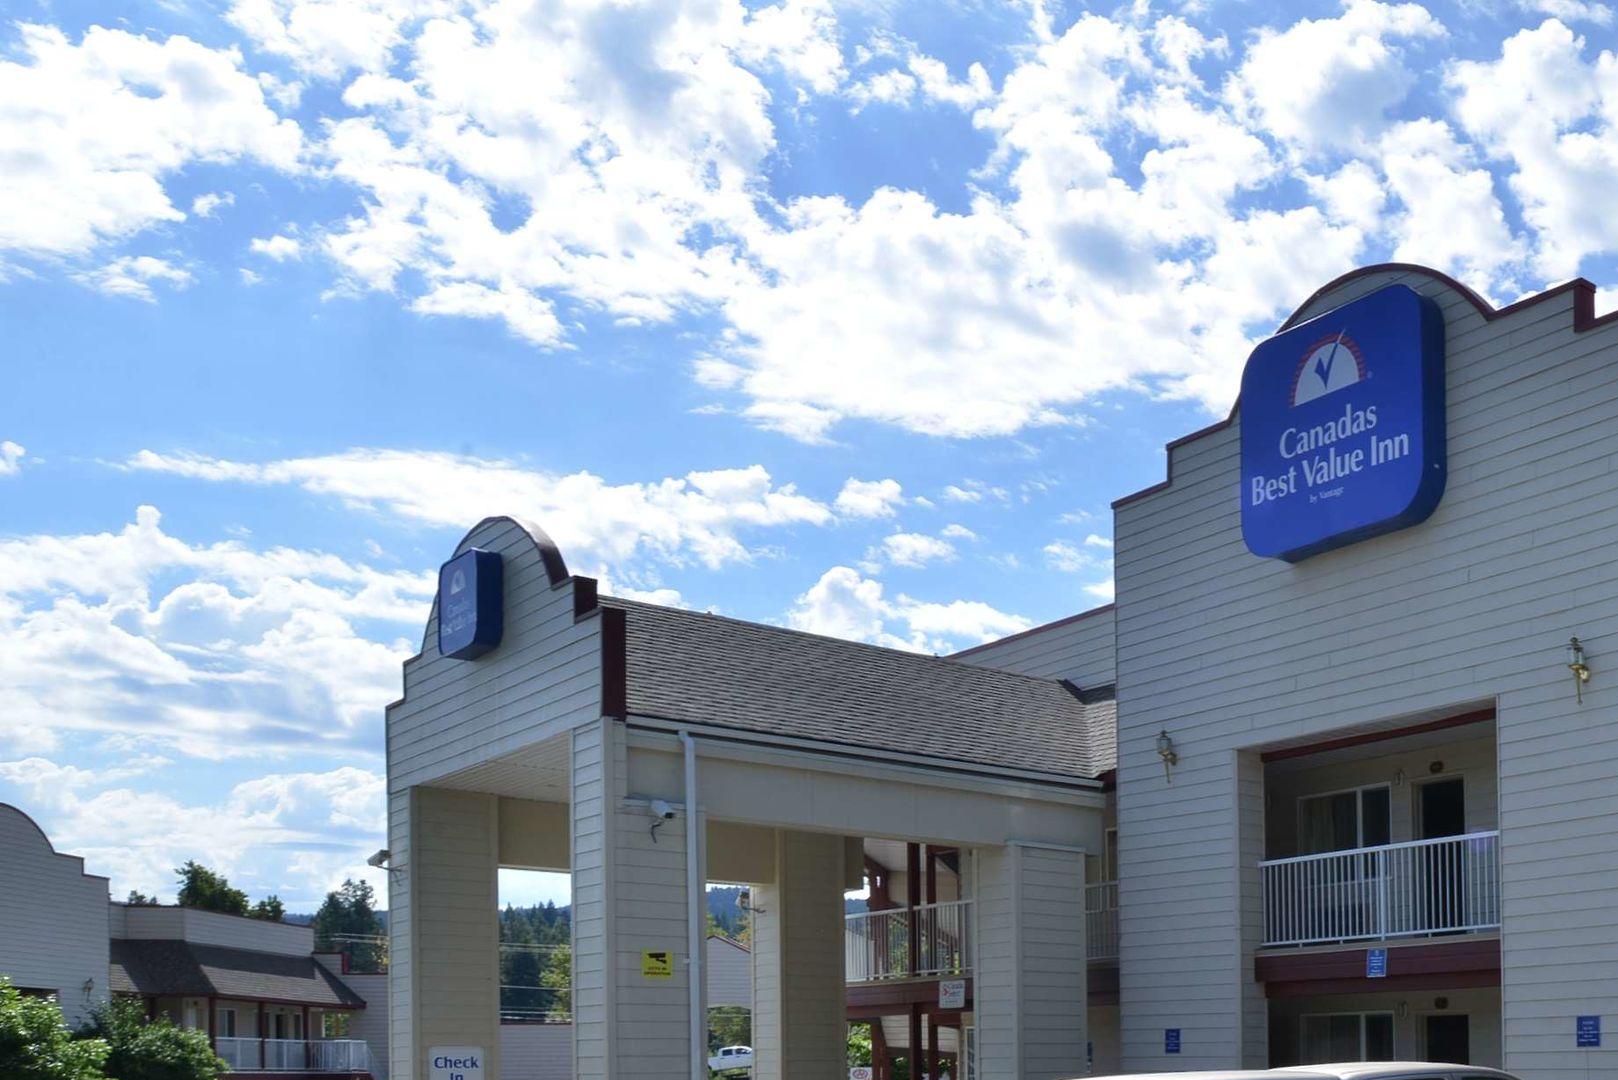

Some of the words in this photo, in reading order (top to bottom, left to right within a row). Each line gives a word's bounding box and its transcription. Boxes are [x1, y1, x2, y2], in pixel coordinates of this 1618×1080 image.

[1279, 403, 1377, 459] Canadas
[1252, 467, 1297, 506] Best
[1302, 447, 1364, 487] Value
[1370, 433, 1409, 466] Inn
[434, 1056, 479, 1069] Check
